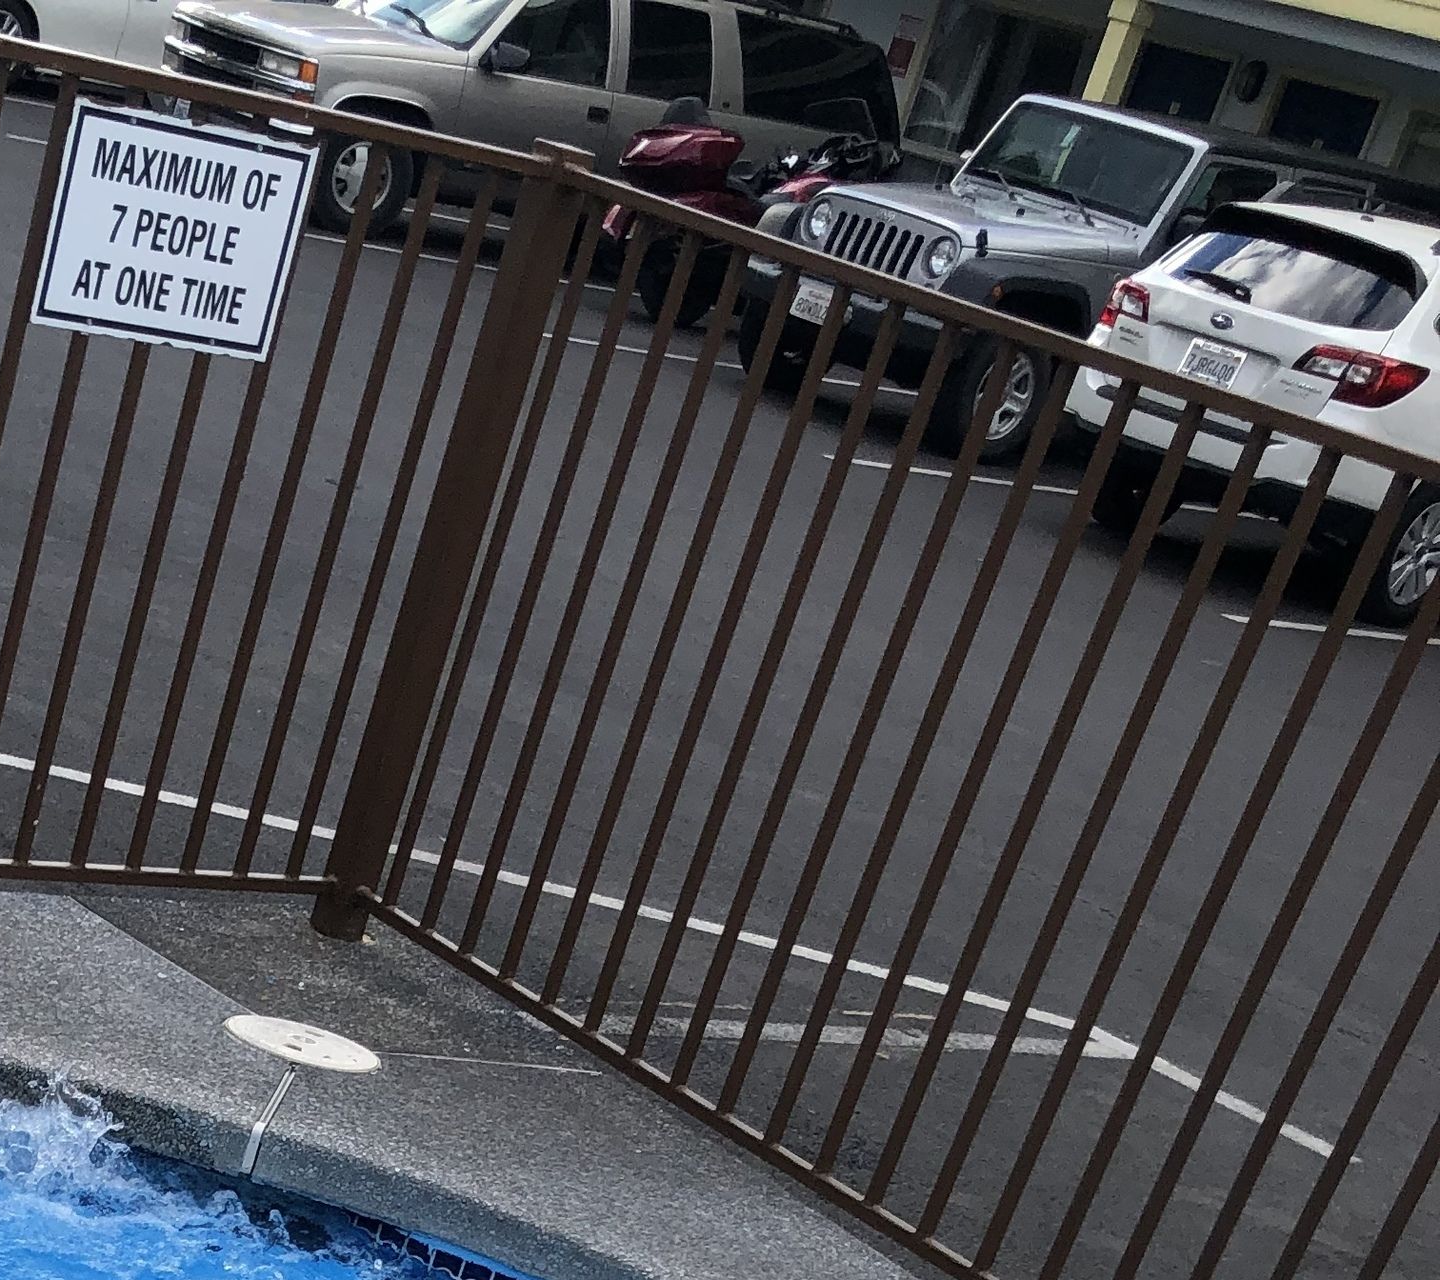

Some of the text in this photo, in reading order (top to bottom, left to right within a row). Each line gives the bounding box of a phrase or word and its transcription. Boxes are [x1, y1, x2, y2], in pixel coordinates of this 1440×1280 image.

[92, 138, 281, 212] MAXIMUM OF
[109, 204, 240, 265] 7 PEOPLE
[72, 260, 247, 325] AT ONE TIME
